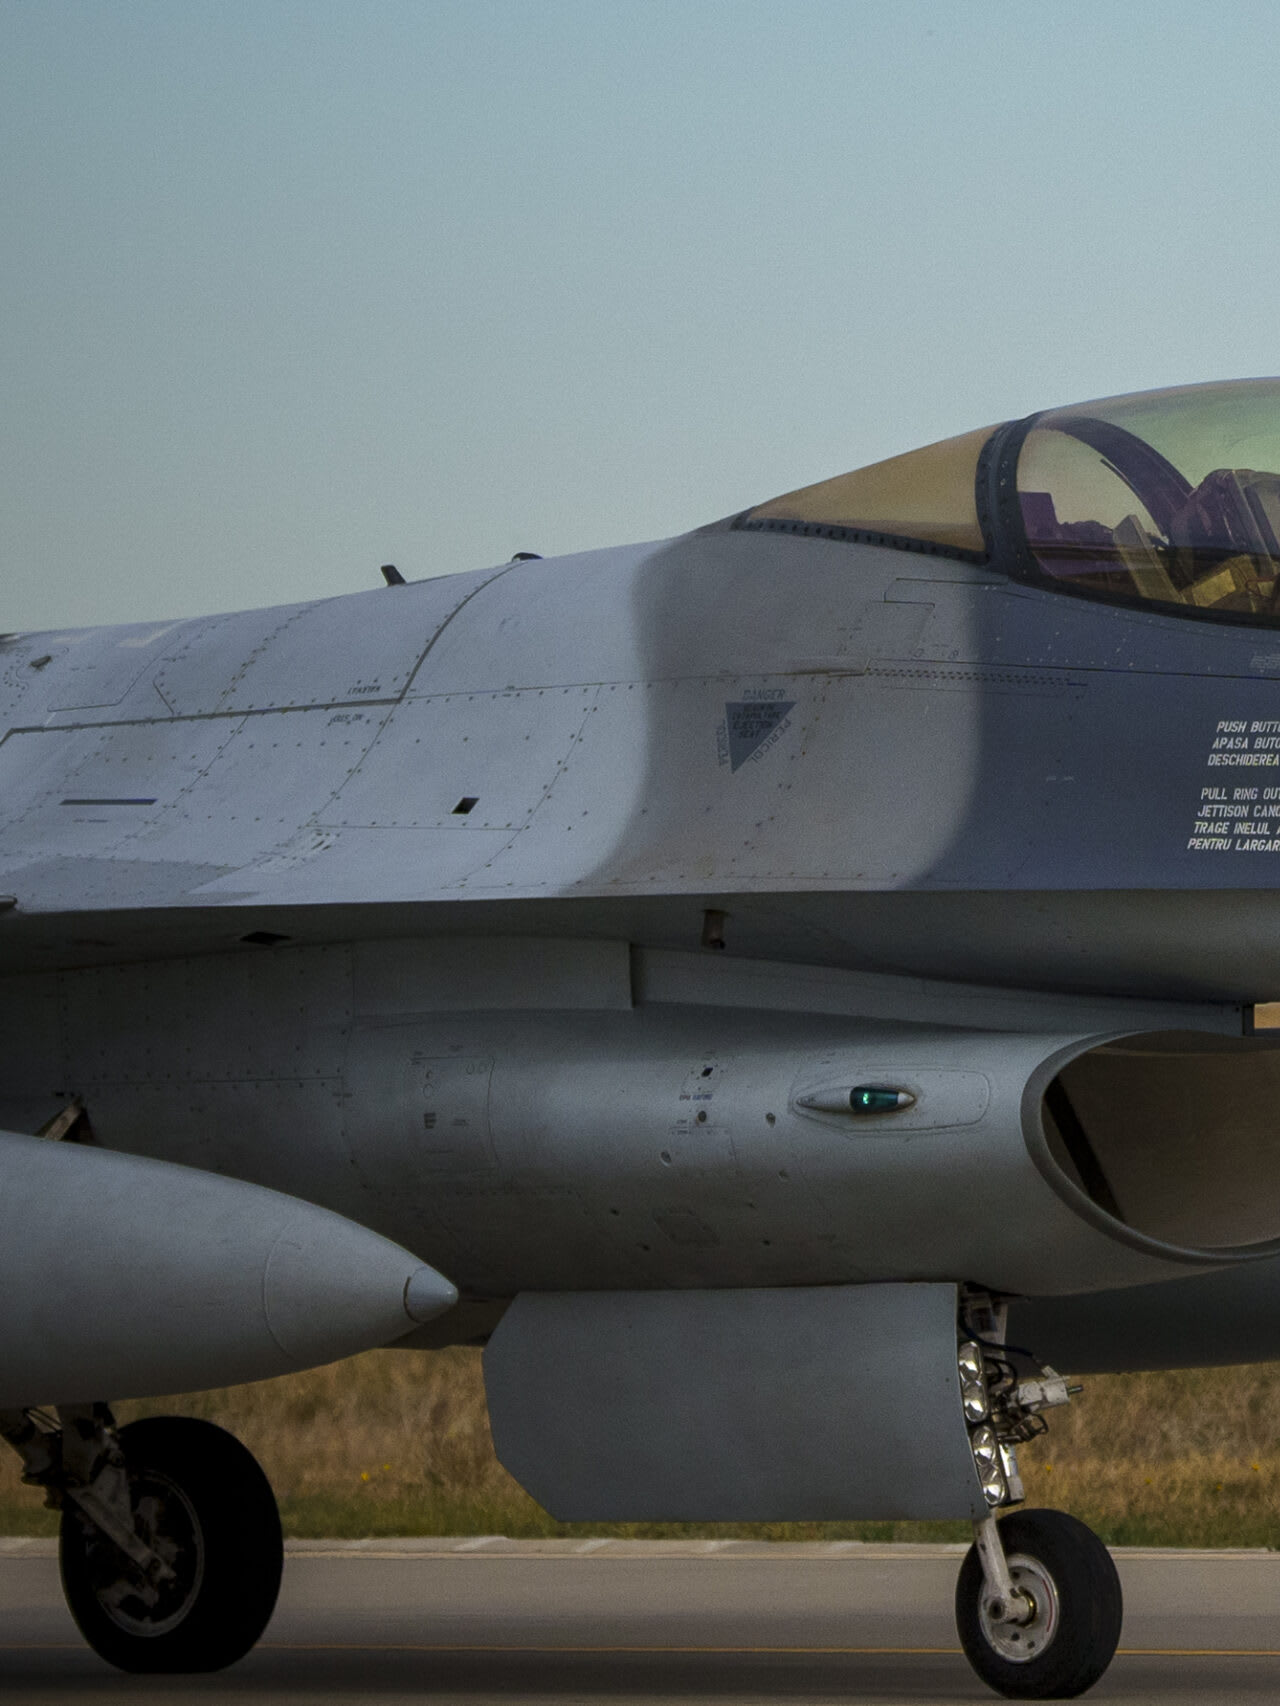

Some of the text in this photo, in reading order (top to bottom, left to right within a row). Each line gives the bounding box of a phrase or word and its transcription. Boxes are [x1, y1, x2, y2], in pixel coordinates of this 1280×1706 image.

[1216, 721, 1247, 733] PUSH
[1212, 738, 1248, 749] APASA
[1208, 754, 1279, 766] DESCHIDEREA
[1201, 788, 1227, 800] PULL
[1233, 788, 1258, 800] RING
[1198, 805, 1250, 817] JETTISON
[1194, 822, 1230, 834] TRAGE
[1234, 822, 1270, 834] INELUL
[1187, 839, 1232, 850] PENTRU
